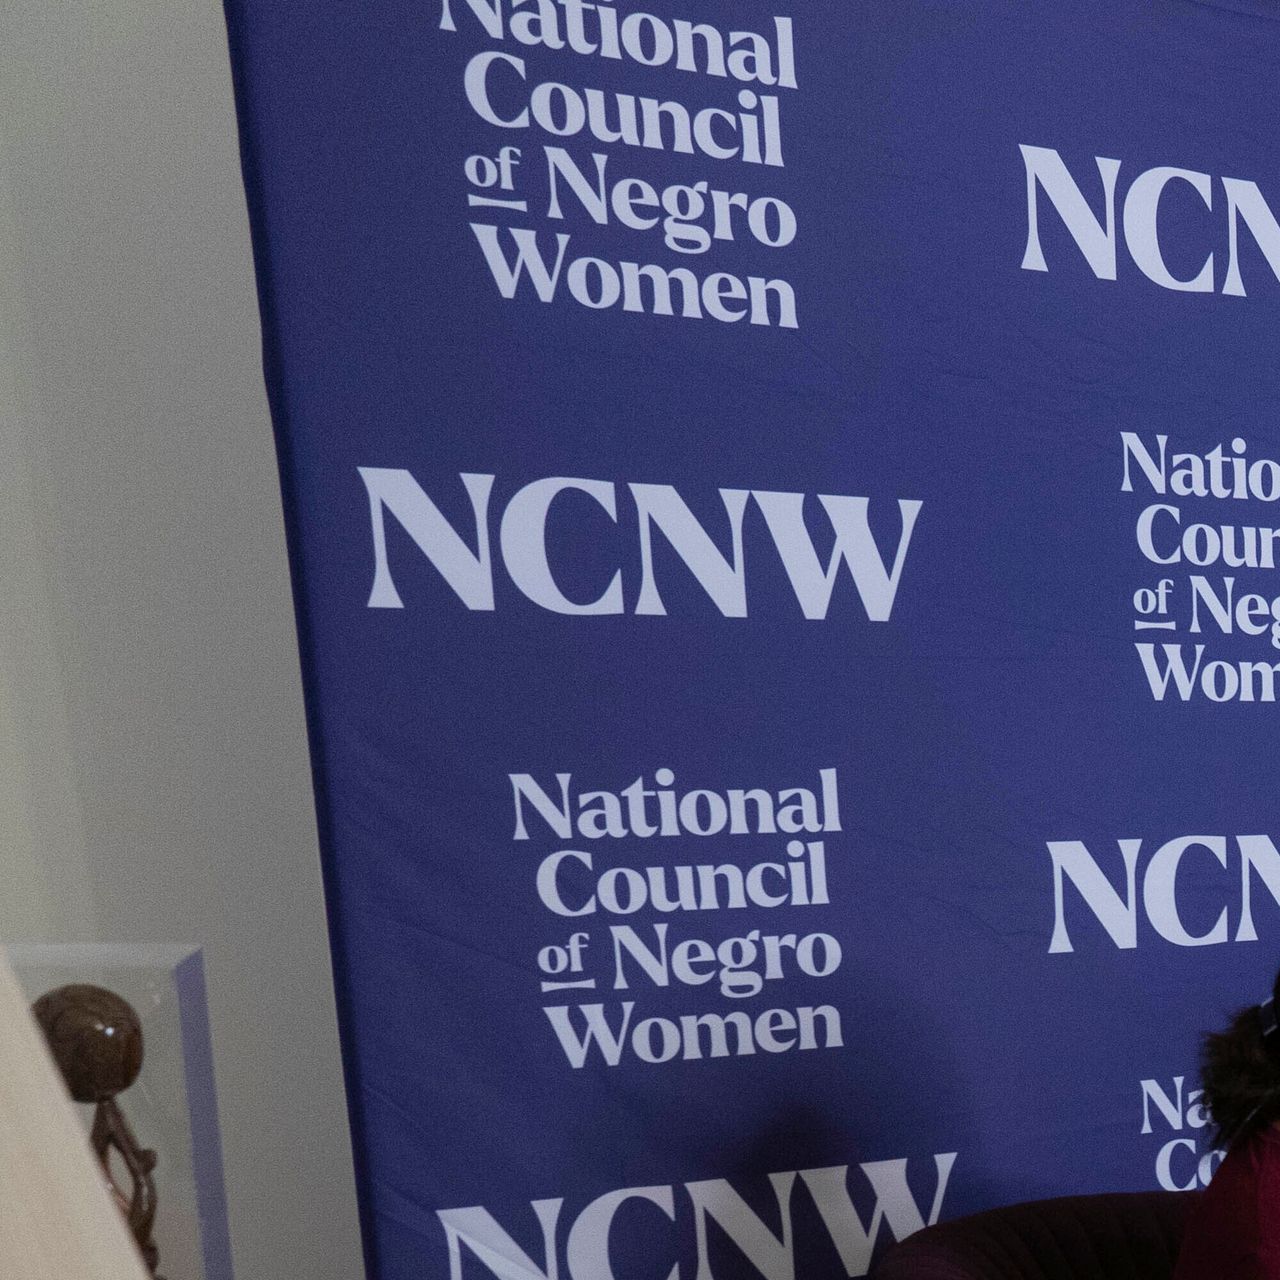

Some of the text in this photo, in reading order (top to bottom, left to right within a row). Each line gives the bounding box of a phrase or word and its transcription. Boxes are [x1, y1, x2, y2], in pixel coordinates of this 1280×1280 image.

[464, 51, 784, 168] Council
[464, 146, 799, 255] of Negro
[470, 223, 799, 329] Women
[357, 465, 924, 622] NCNW
[1132, 579, 1174, 618] of
[507, 767, 843, 841] National
[535, 840, 831, 918] Council
[536, 922, 843, 999] of Negro
[542, 1001, 844, 1070] Women
